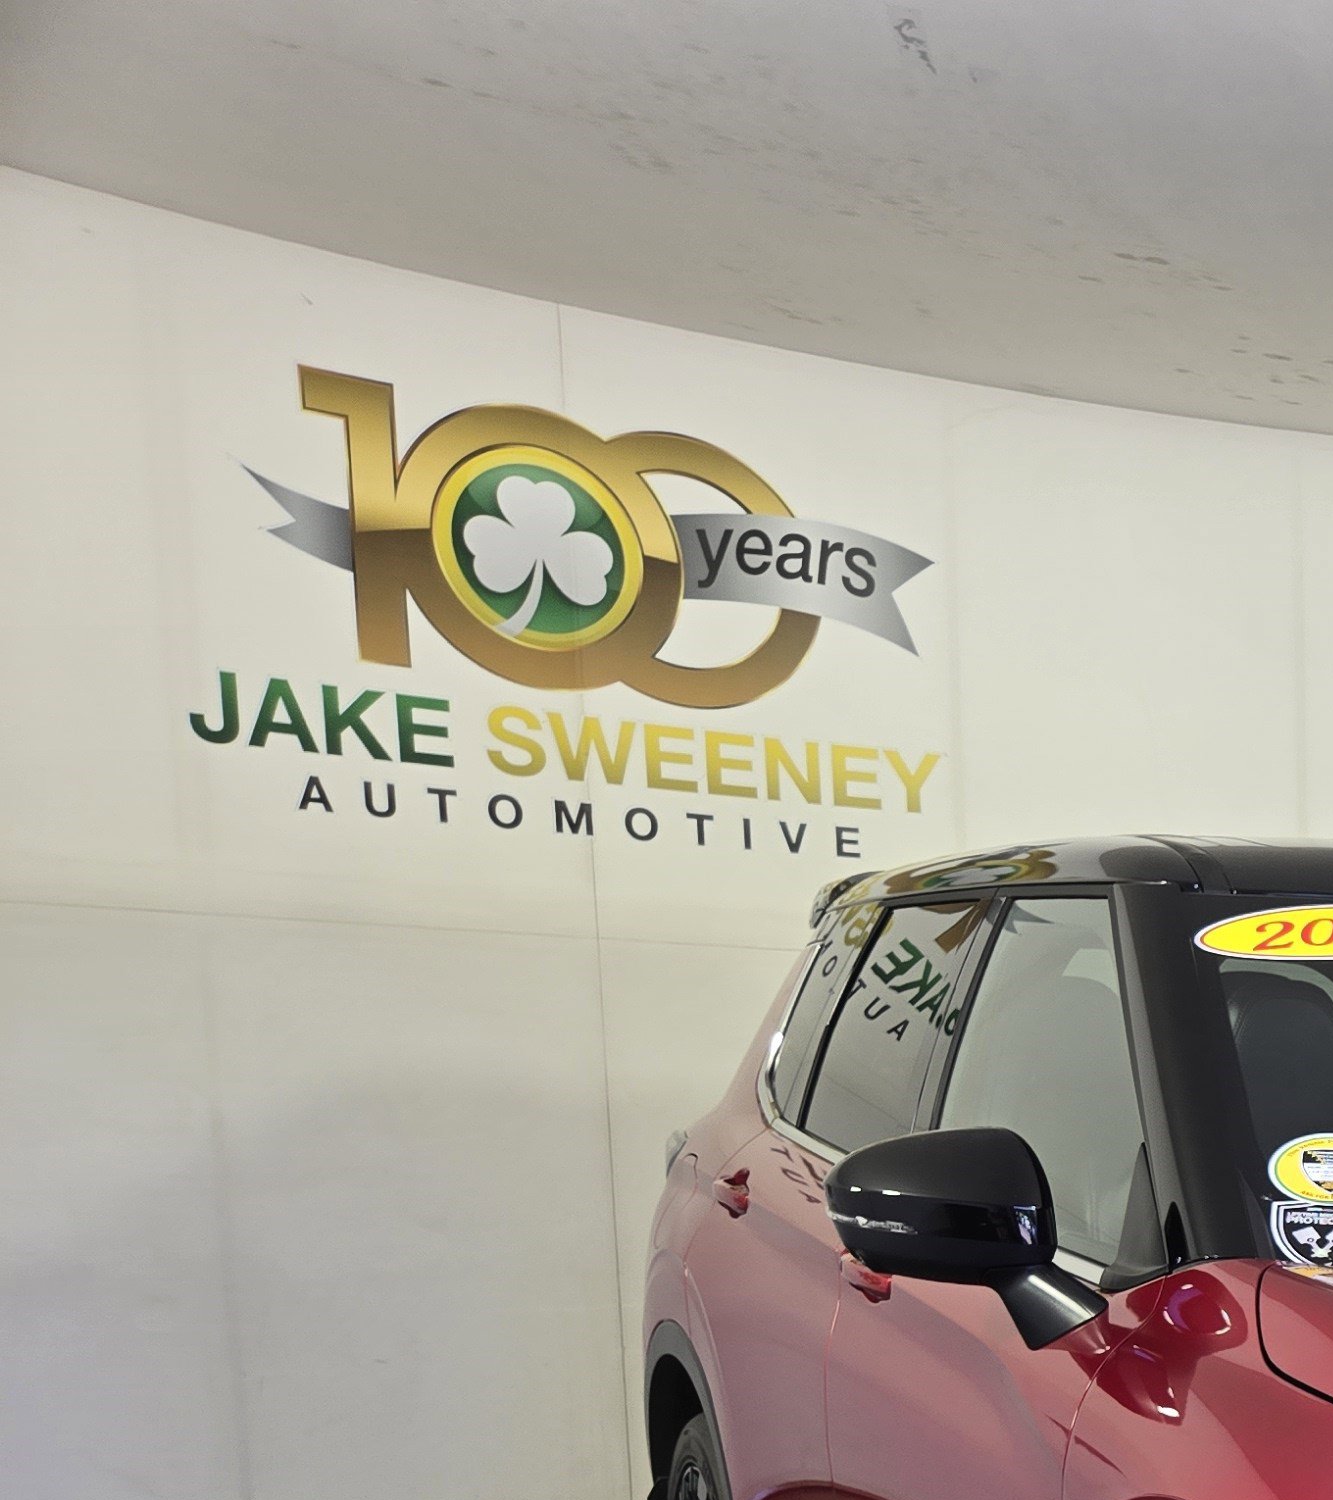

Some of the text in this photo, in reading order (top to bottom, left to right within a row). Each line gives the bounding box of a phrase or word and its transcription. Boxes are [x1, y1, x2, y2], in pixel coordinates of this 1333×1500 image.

[297, 364, 878, 709] 100 years
[188, 670, 942, 814] JAKE SWEENEY
[298, 774, 862, 860] AUTOMOTIVE
